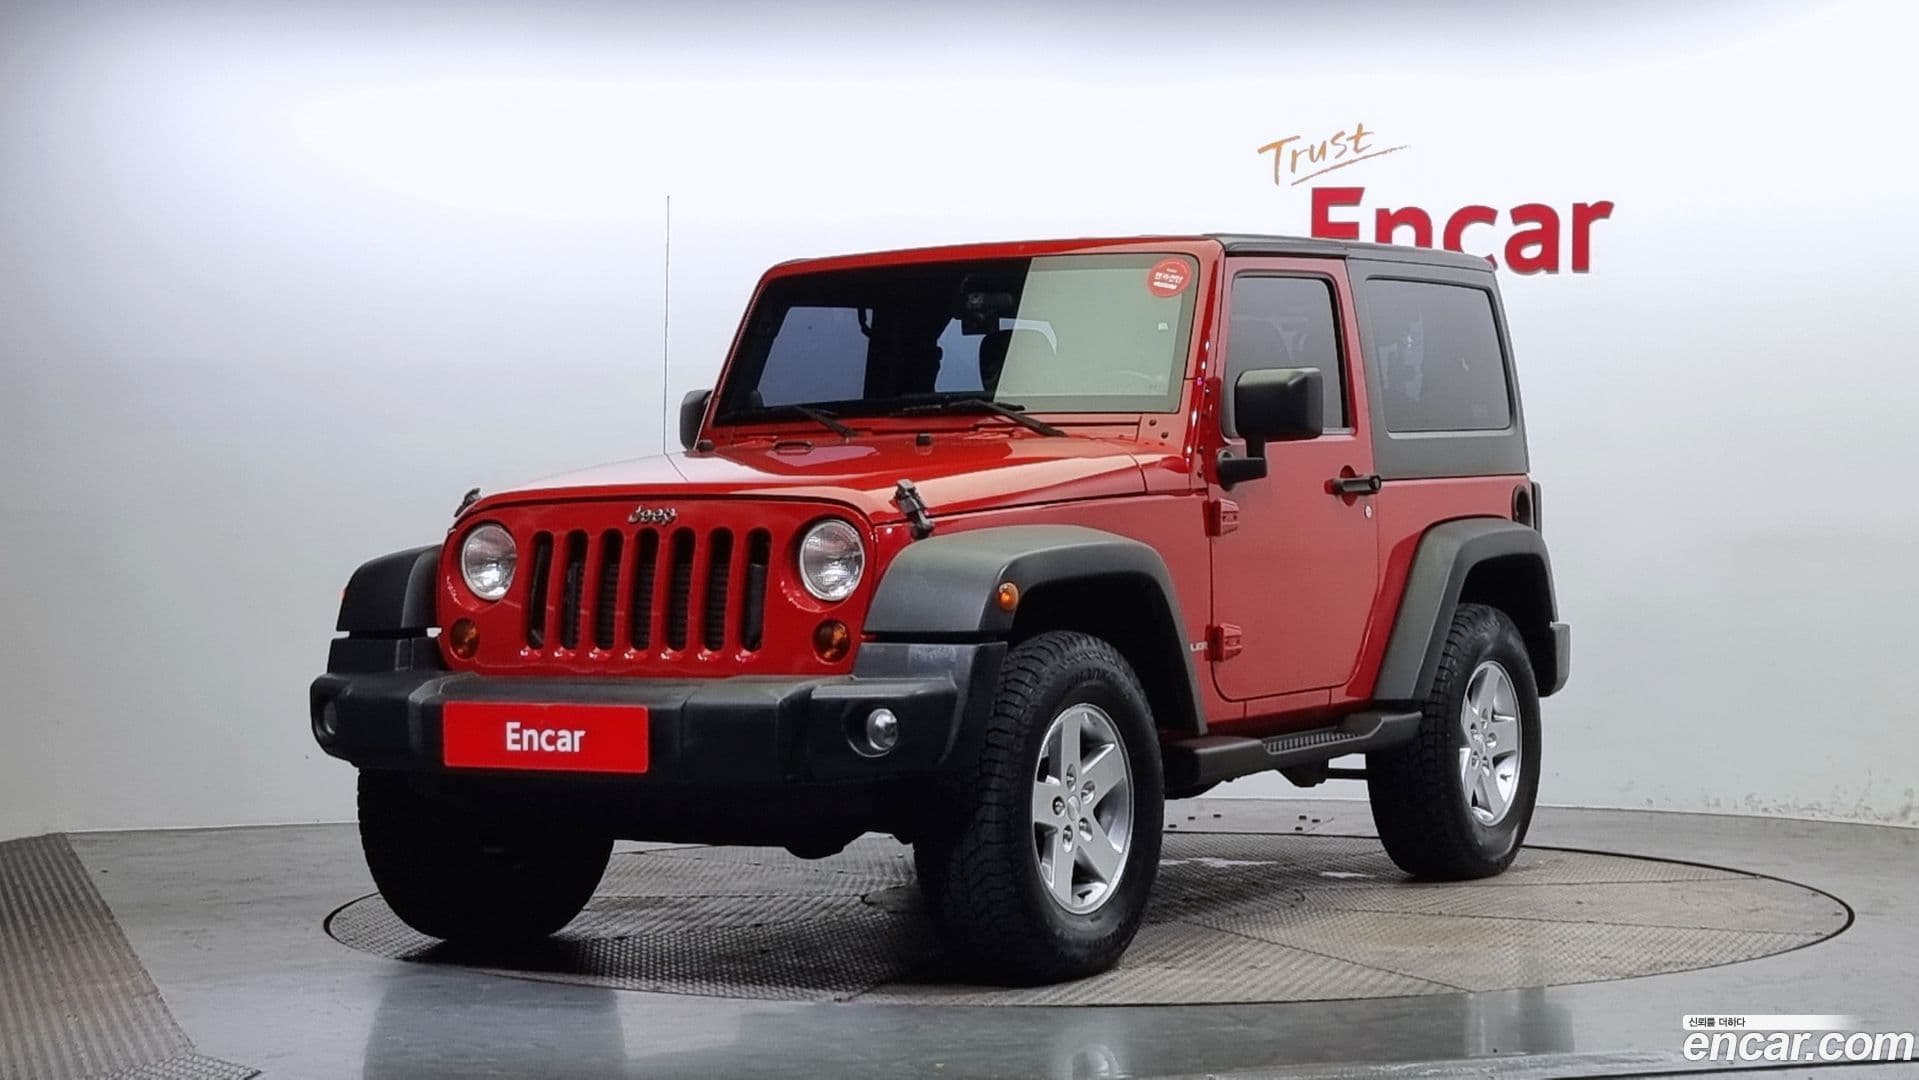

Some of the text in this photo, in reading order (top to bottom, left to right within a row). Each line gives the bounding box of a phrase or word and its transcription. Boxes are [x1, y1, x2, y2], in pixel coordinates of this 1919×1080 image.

[1257, 122, 1375, 186] Trust
[1311, 186, 1615, 274] Encar
[627, 504, 677, 526] Jeep
[505, 721, 587, 753] Encar
